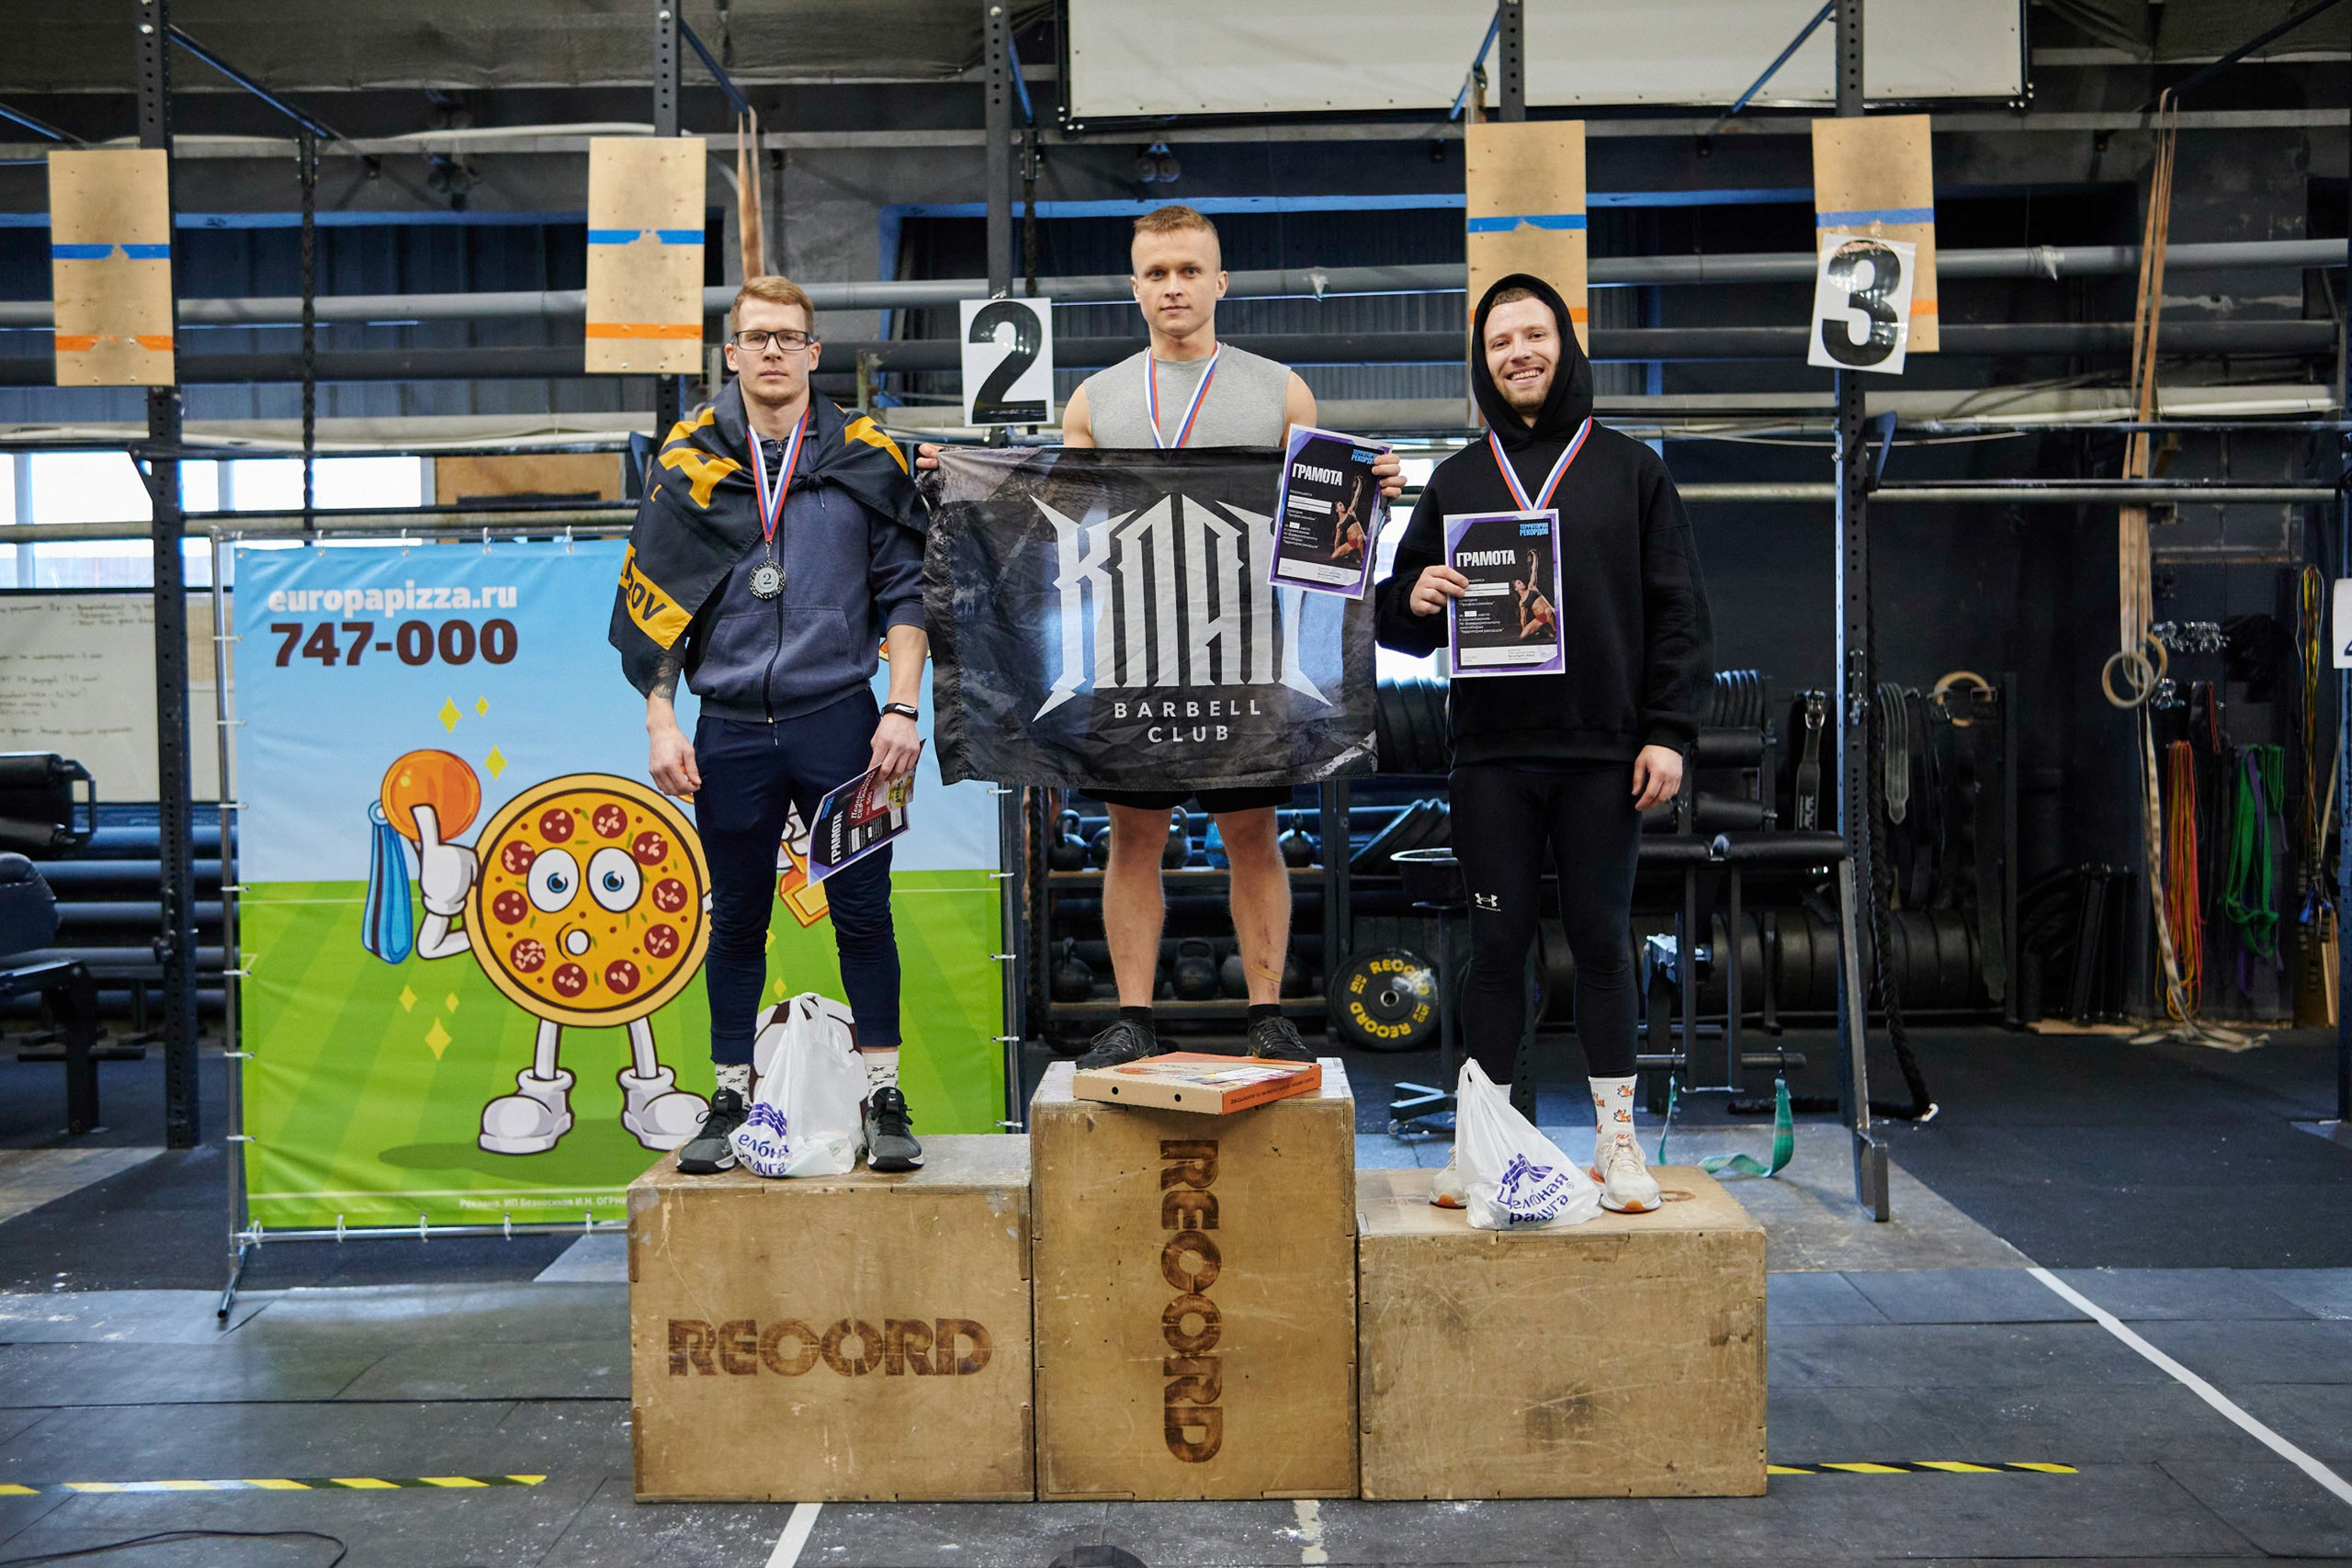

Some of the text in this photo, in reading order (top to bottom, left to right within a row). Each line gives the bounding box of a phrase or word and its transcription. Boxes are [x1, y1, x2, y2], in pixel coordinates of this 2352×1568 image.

[1822, 240, 1901, 366] 3
[969, 301, 1047, 424] 2
[1292, 463, 1343, 487] ГРАМОТА
[1520, 528, 1549, 536] РЕКОРДОВ
[1456, 549, 1516, 568] ГРАМОТА
[763, 572, 772, 585] 2
[267, 580, 517, 618] europapizza.ru
[270, 618, 518, 667] 747-000
[1114, 699, 1261, 718] BARBELL
[1148, 725, 1228, 743] CLUB
[831, 809, 844, 864] ГРАМОТА
[1350, 1001, 1411, 1038] RECORD
[504, 1198, 518, 1208] ИП
[1510, 1194, 1568, 1224] радуга
[1159, 1139, 1223, 1463] RECORD
[668, 1318, 993, 1378] RECORD
